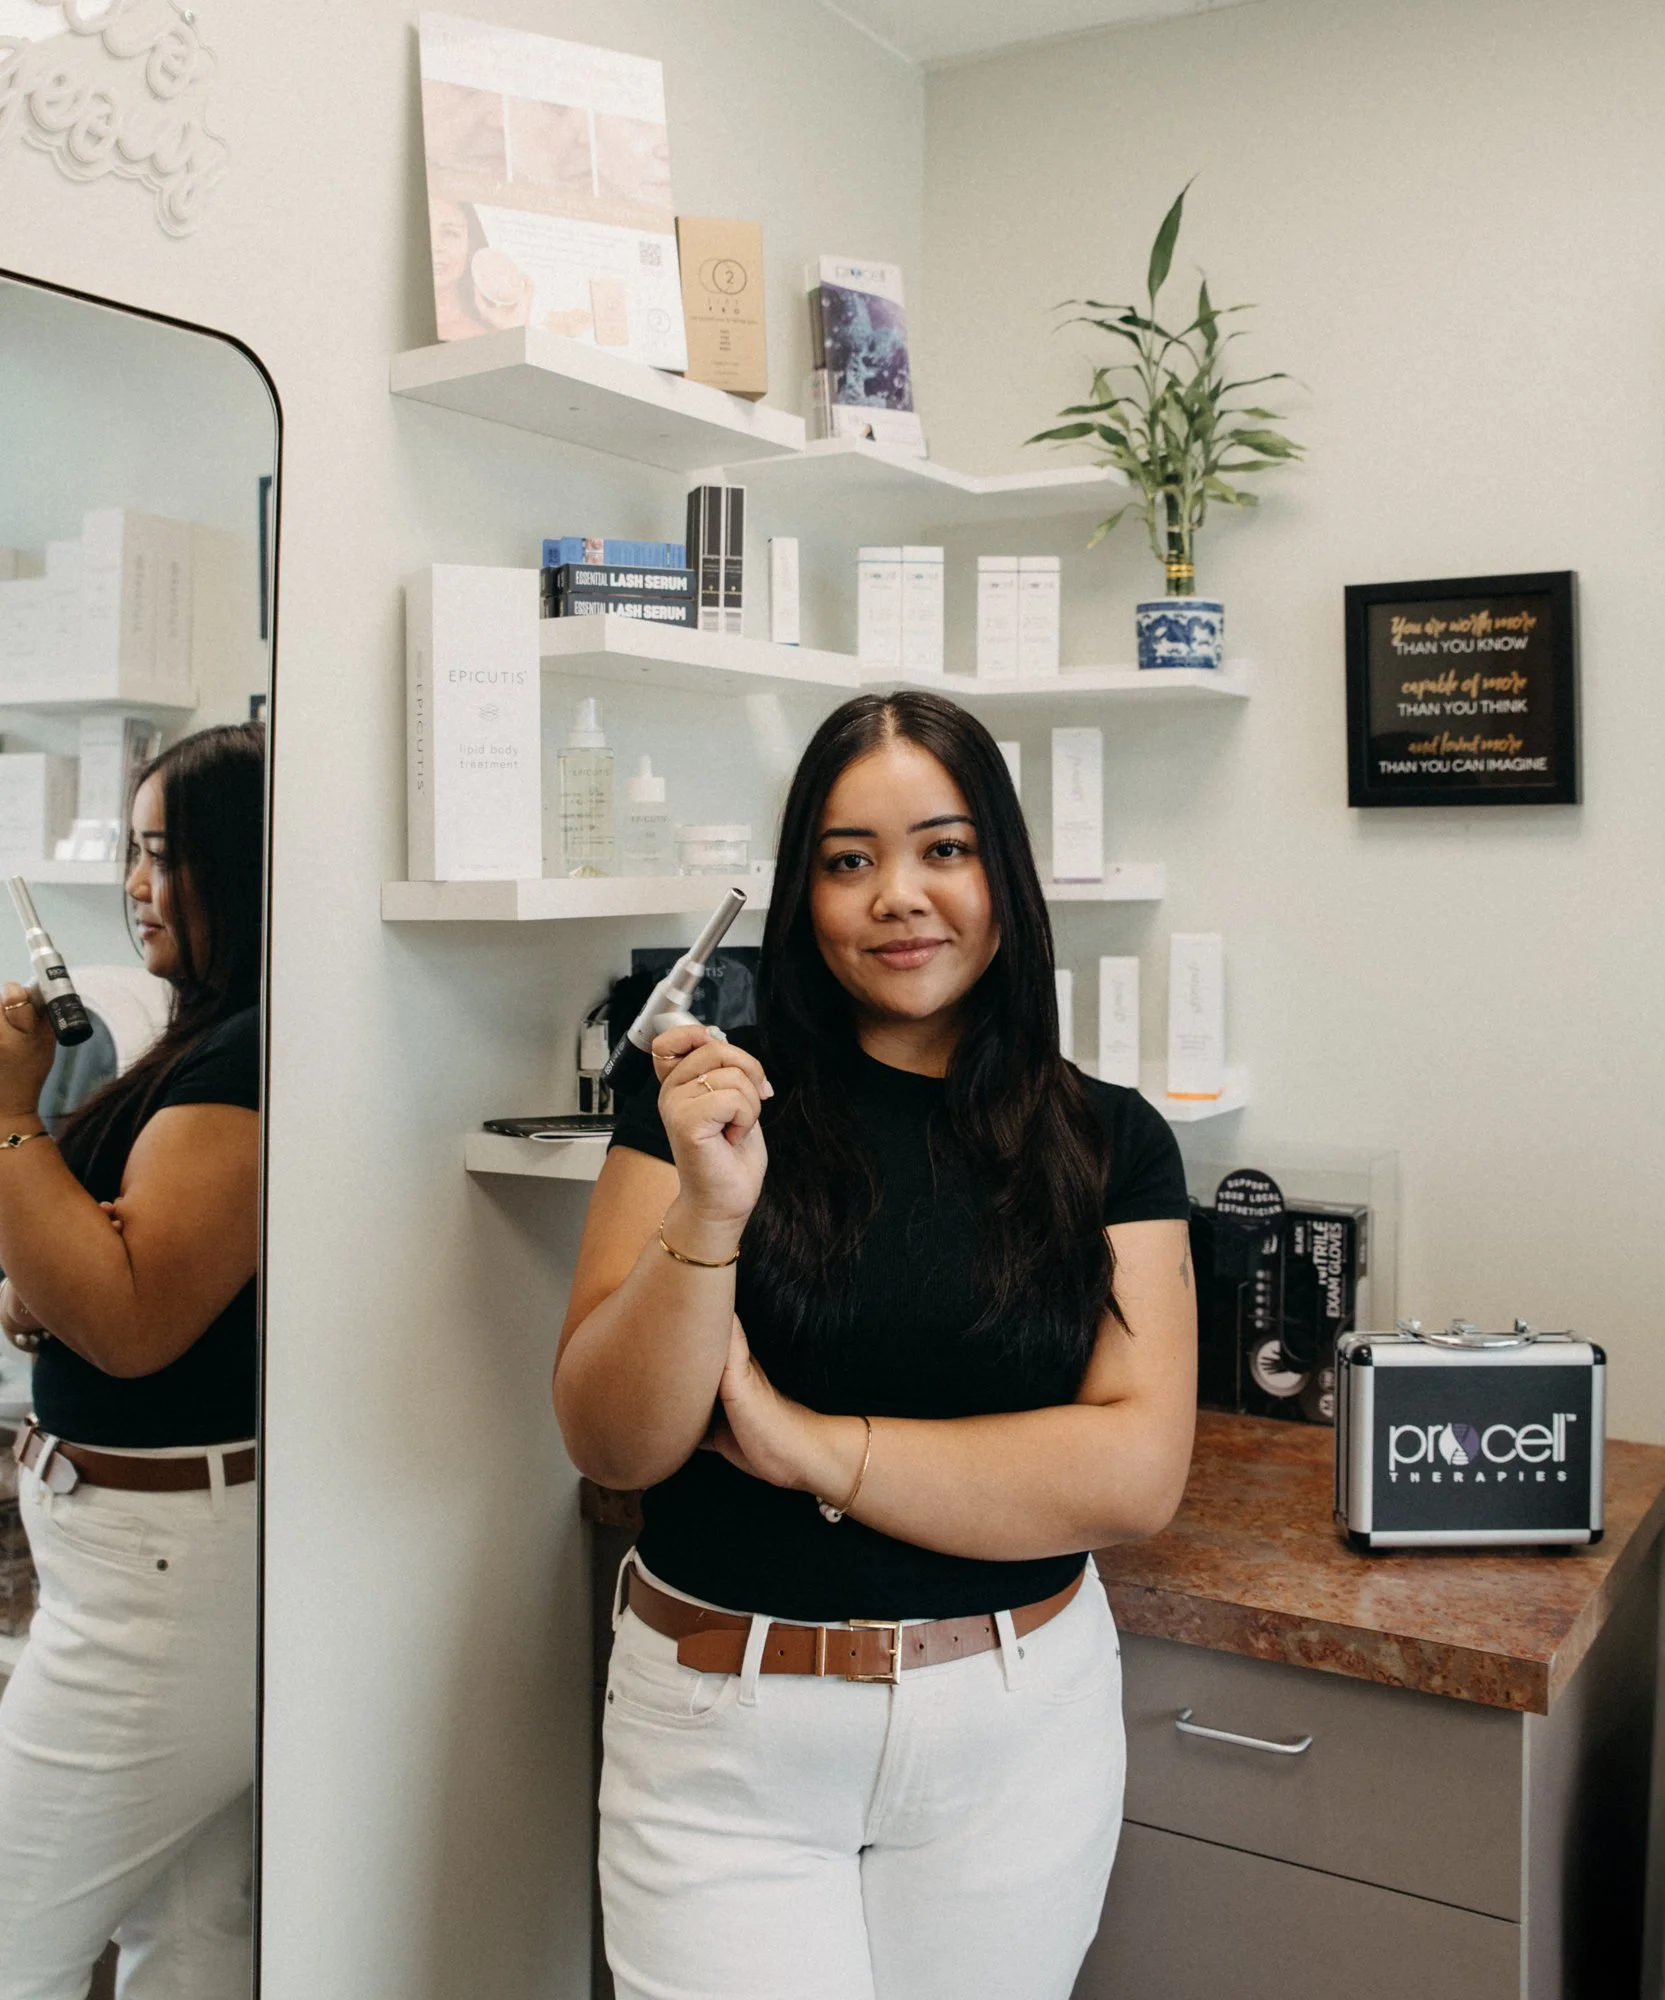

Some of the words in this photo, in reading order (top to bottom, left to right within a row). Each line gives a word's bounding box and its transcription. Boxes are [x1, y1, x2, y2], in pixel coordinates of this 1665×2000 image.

[575, 570, 608, 587] ESSENTIAL
[609, 572, 643, 589] LASH
[644, 574, 688, 591] SERUM
[574, 600, 606, 616] ESSENTIAL
[608, 602, 642, 618] LASH
[643, 604, 686, 621] SERUM
[1449, 610, 1492, 637] worth
[1494, 611, 1536, 633] more
[1396, 641, 1438, 655] THAN
[1440, 639, 1475, 654] YOU
[1476, 636, 1529, 652] KNOW
[448, 669, 527, 685] EPICUTIS
[1401, 669, 1459, 700] capable
[1461, 672, 1481, 699] of
[1482, 671, 1528, 694] more
[1397, 702, 1440, 716] THAN
[1442, 700, 1478, 715] YOU
[1479, 698, 1528, 713] THINK
[459, 743, 485, 756] lipid
[490, 743, 518, 757] body
[1408, 735, 1441, 755] and
[1481, 733, 1523, 755] more
[459, 759, 519, 769] treatment
[1379, 760, 1417, 774] THAN
[1419, 759, 1450, 773] YOU
[1452, 759, 1485, 773] CAN
[1486, 756, 1548, 772] IMAGINE
[1227, 1178, 1270, 1190] SUPPORT
[1218, 1190, 1245, 1201] YOUR
[1249, 1192, 1281, 1203] LOCAL
[1327, 1222, 1342, 1276] GLOVES
[1326, 1277, 1341, 1318] EXAM
[1389, 1471, 1568, 1483] THERAPIES
